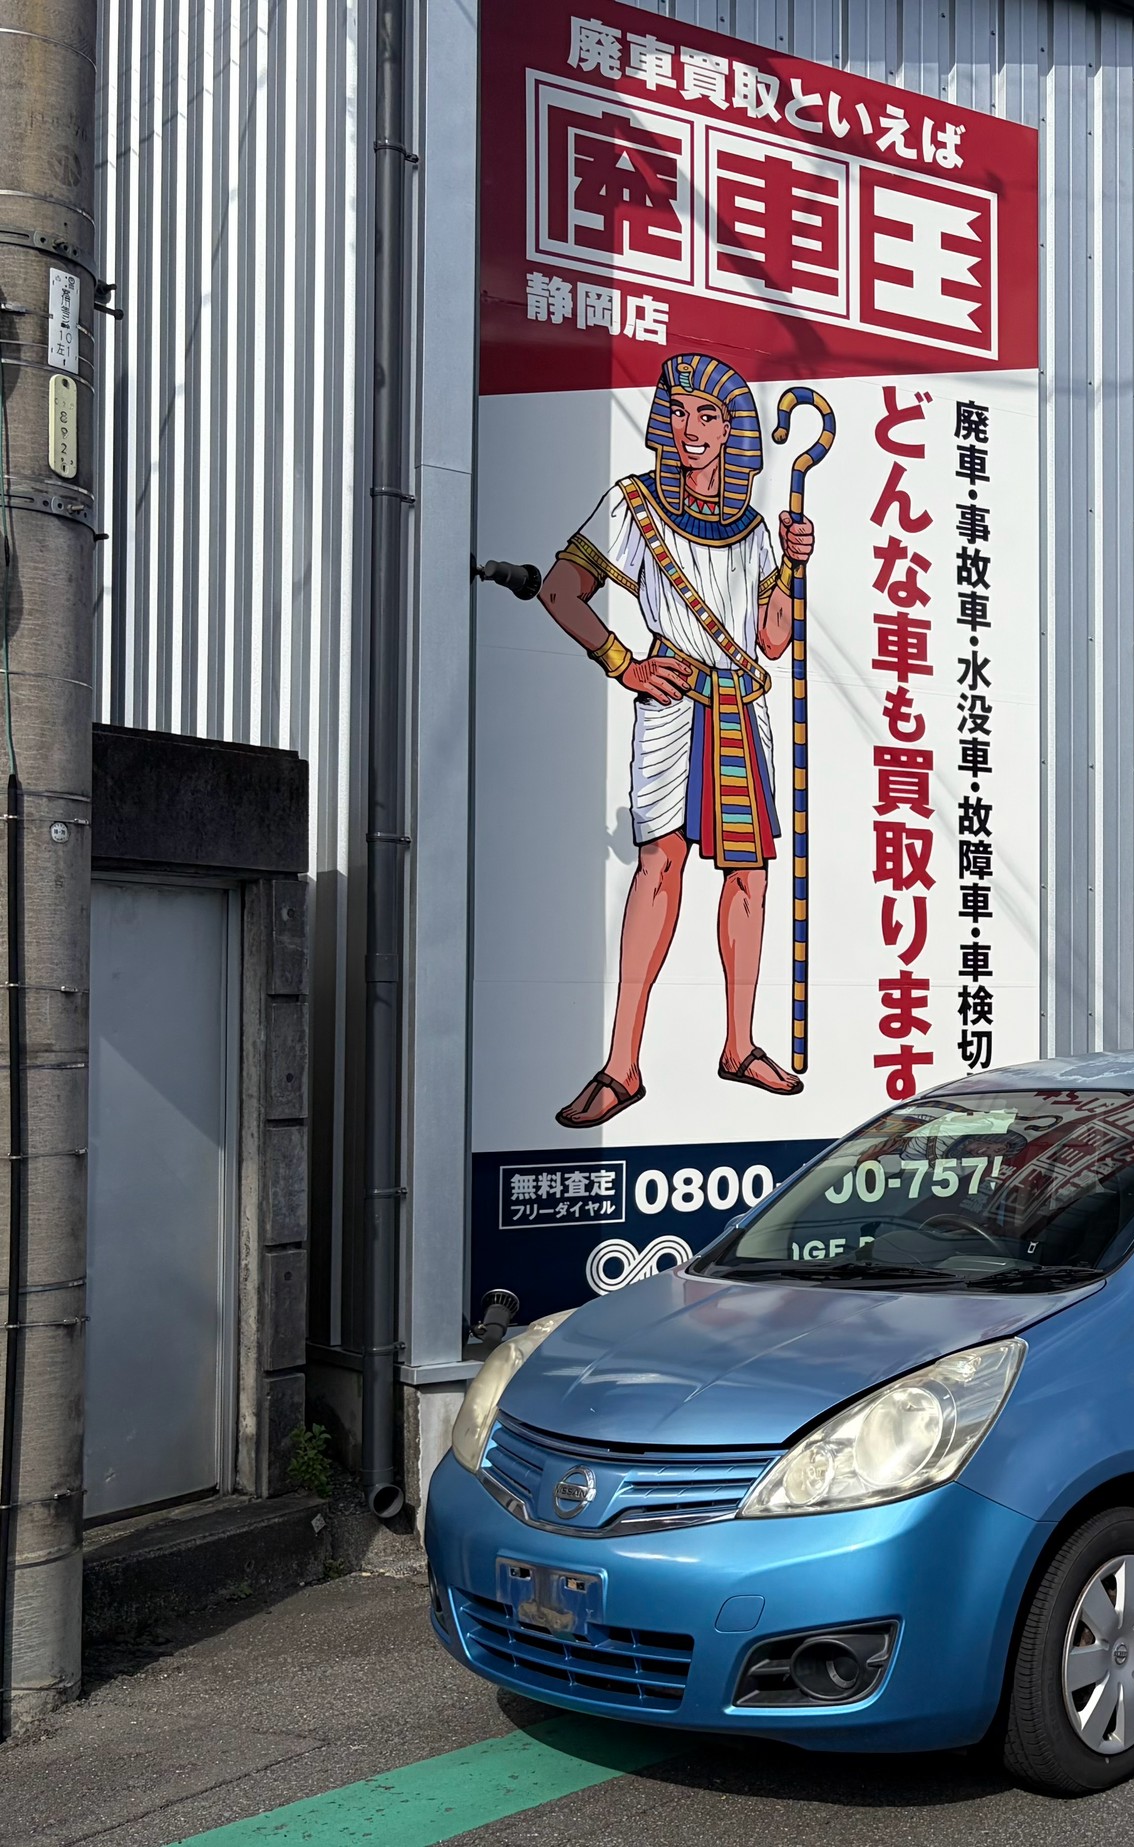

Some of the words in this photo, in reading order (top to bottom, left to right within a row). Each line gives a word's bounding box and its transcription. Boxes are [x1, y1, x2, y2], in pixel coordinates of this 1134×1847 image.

[567, 15, 965, 169] 廃車買取といえば
[526, 68, 999, 361] 廃車王
[526, 272, 669, 346] 静岡店
[869, 385, 937, 1101] どんな車も買取ります
[953, 400, 993, 1077] 廃車・事故車・水没車・故障車・車検切
[510, 1169, 616, 1200] 無料査定
[510, 1200, 616, 1221] フリーダイヤル
